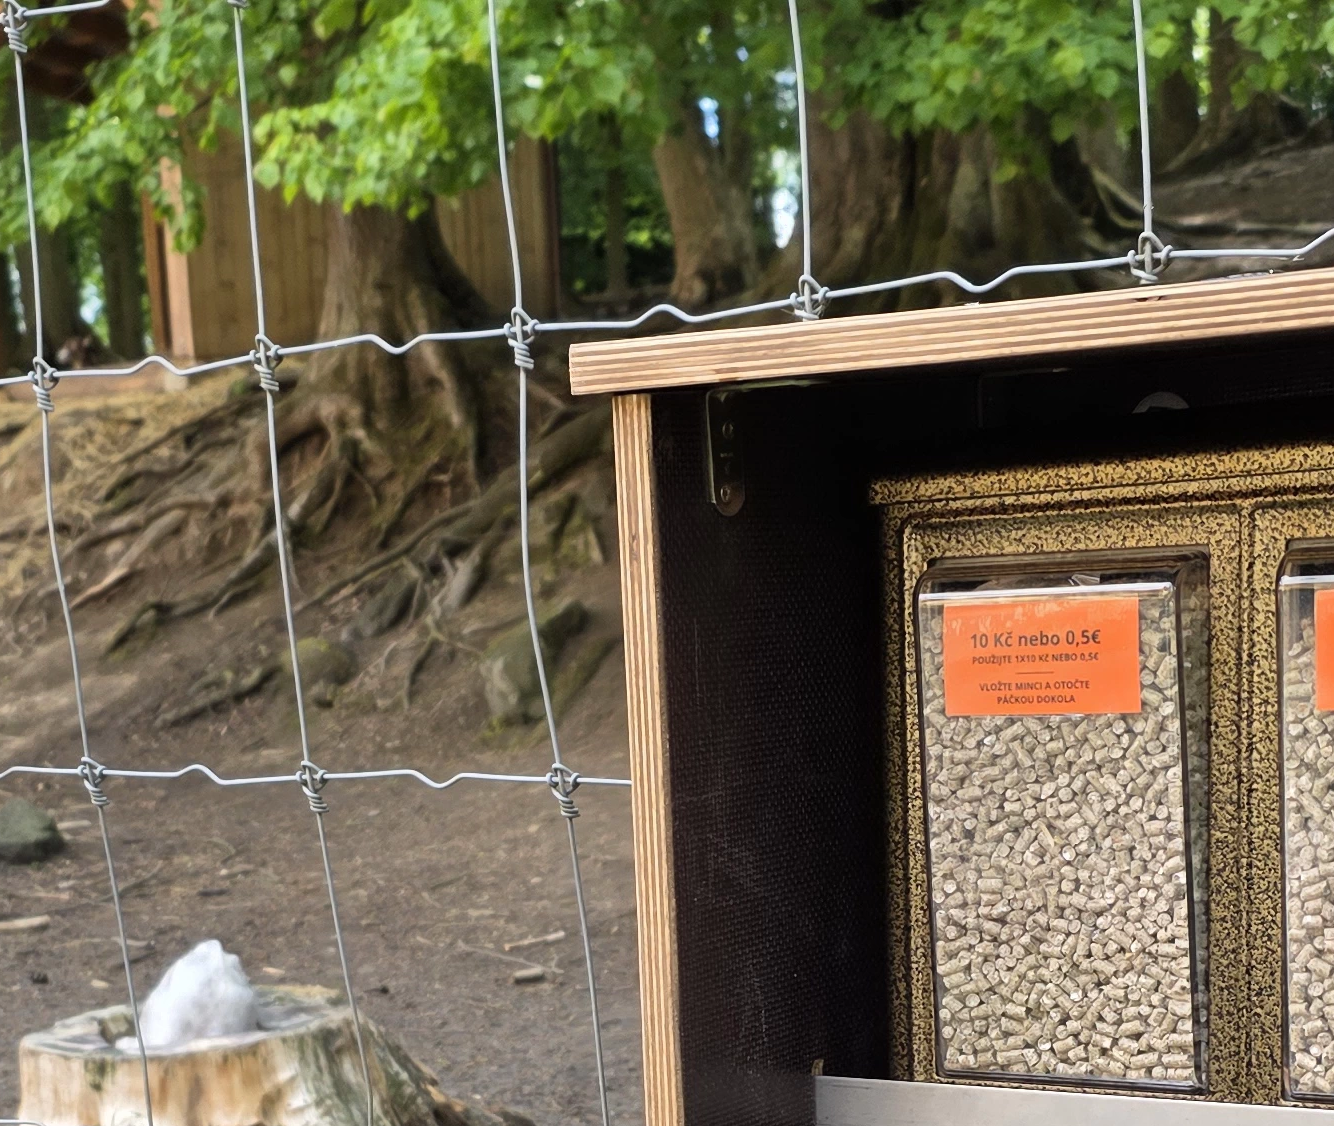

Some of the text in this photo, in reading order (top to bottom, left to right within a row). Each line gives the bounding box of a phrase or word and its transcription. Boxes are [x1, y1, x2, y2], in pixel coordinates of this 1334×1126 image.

[971, 629, 1101, 649] 10 Kč nebo 0,5€
[972, 654, 1011, 666] POUŽIJTE
[1015, 654, 1036, 663] 1X10
[1052, 653, 1077, 662] NEBO
[1079, 652, 1099, 662] 0,5€
[979, 678, 1090, 692] VLOŽTE MINCI A OTOČTE
[997, 694, 1076, 705] PÁČKOU DOKOLA
